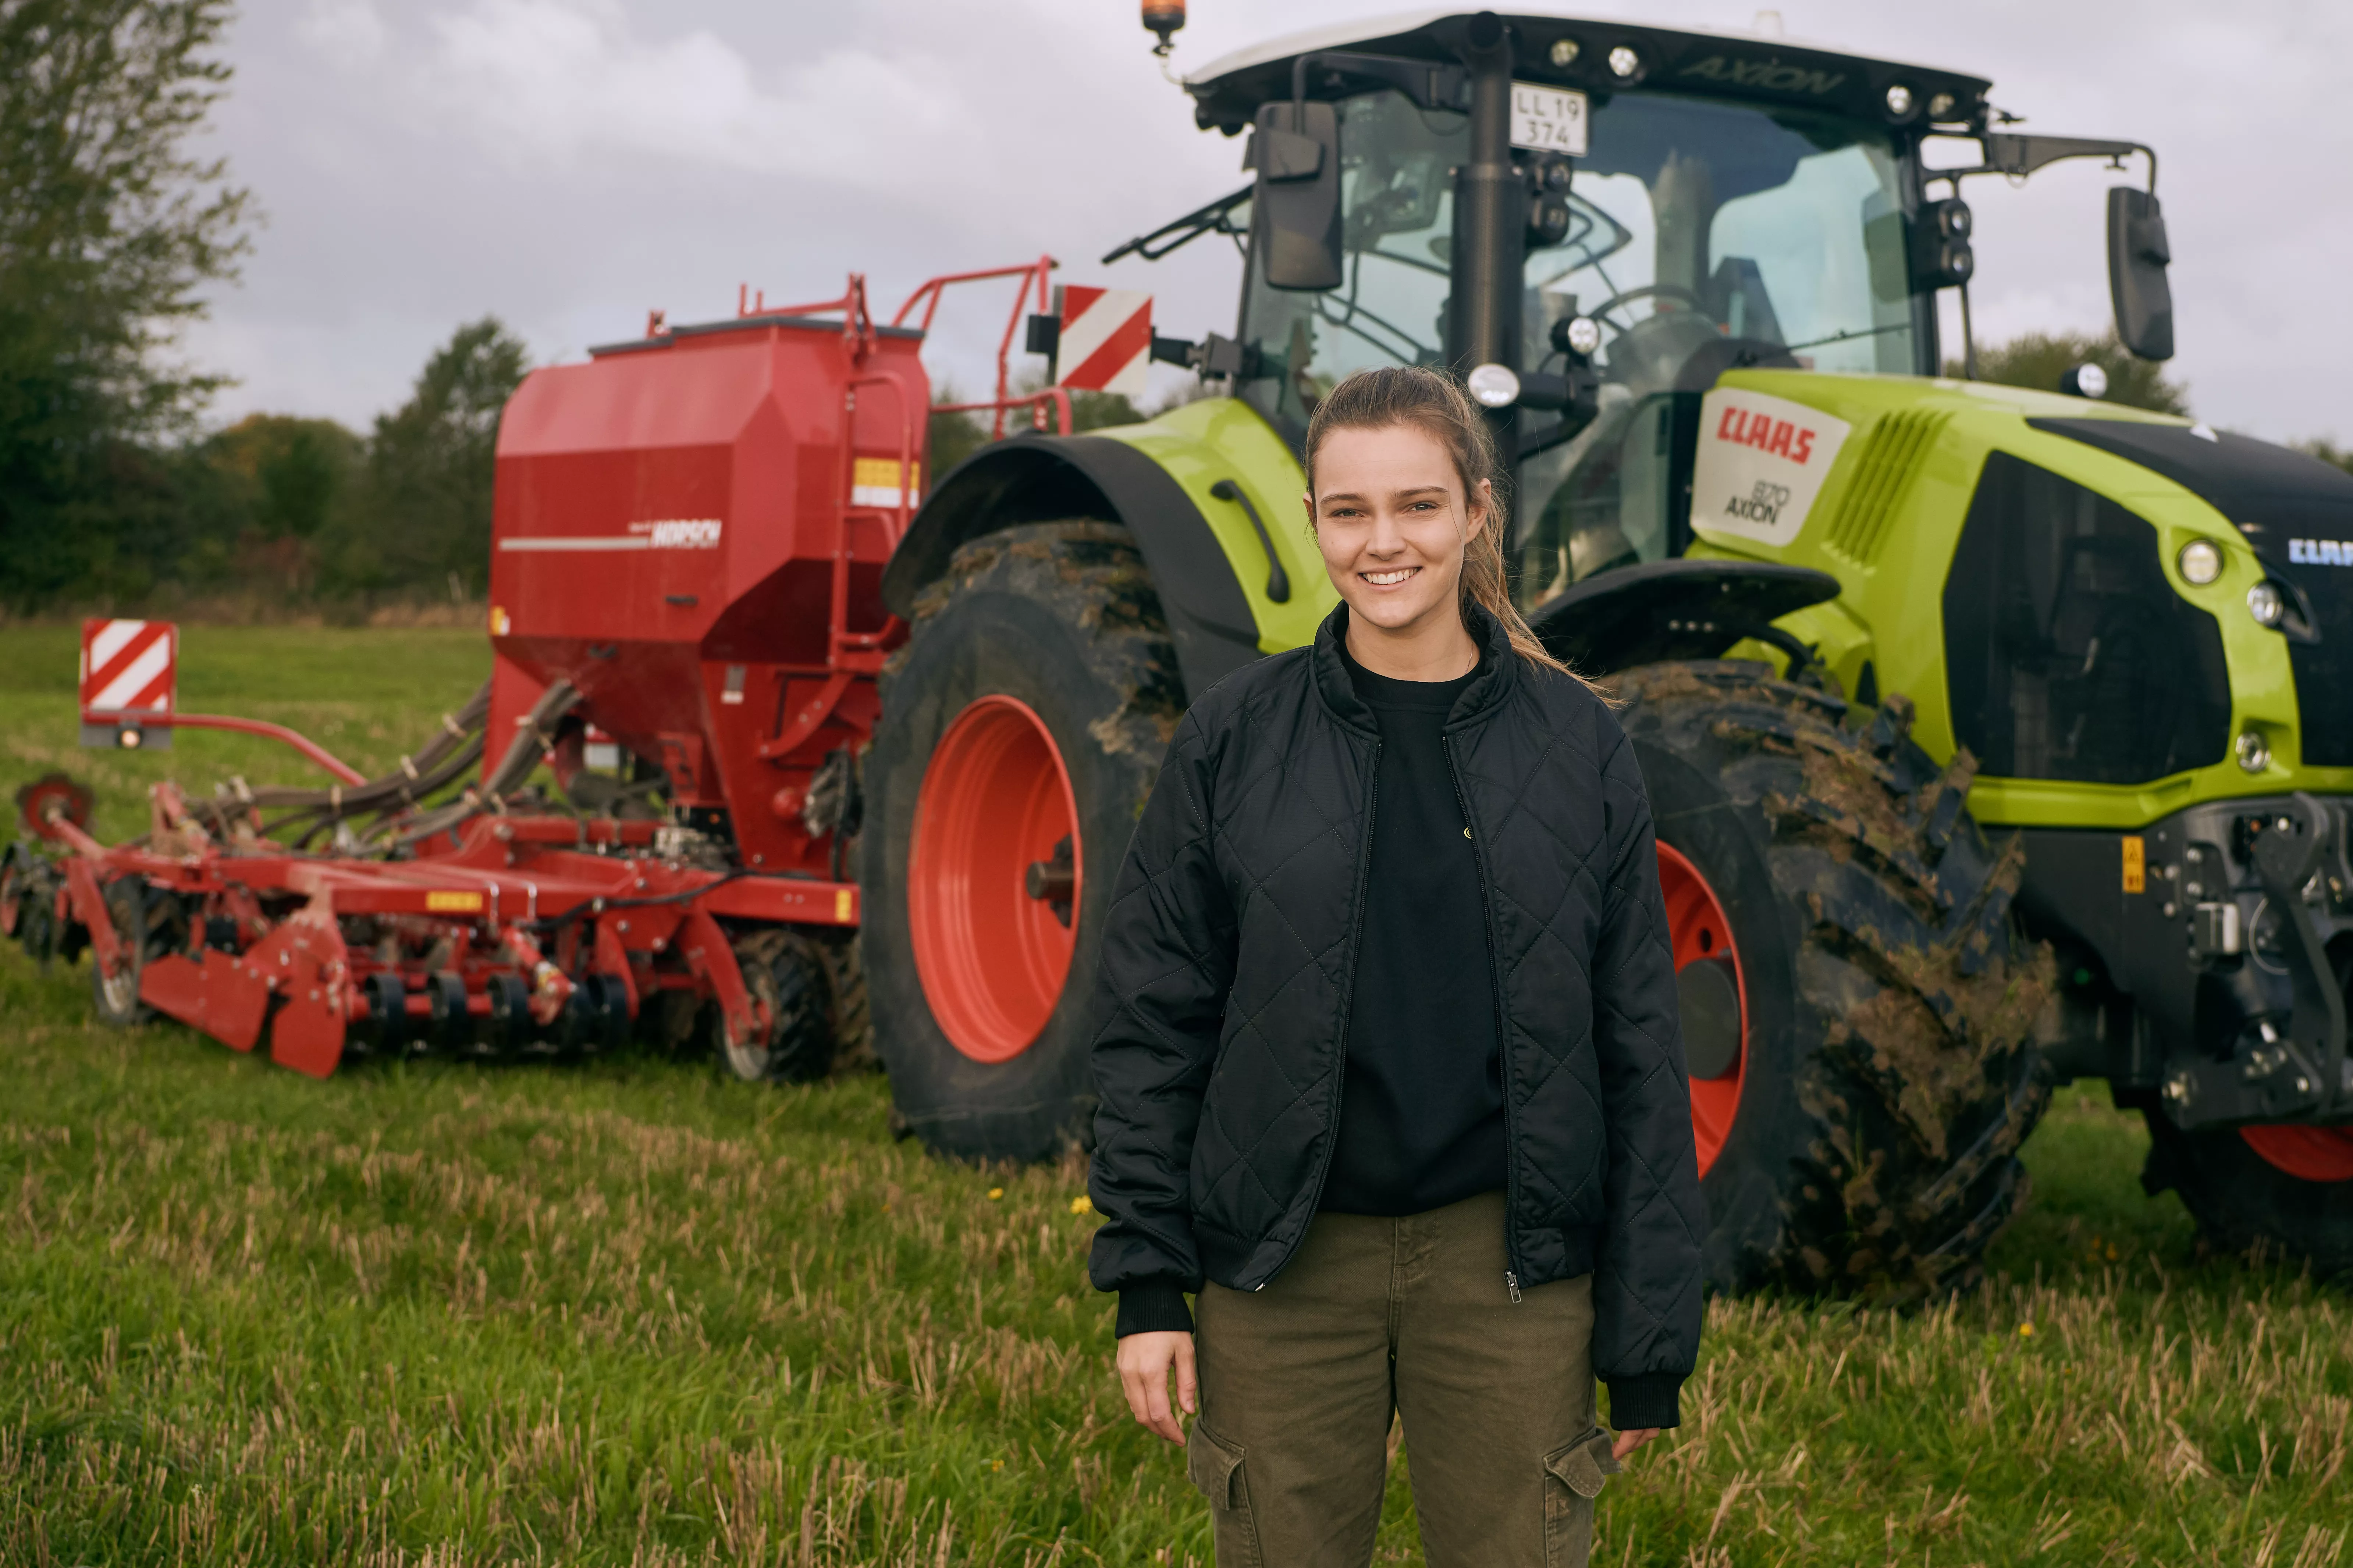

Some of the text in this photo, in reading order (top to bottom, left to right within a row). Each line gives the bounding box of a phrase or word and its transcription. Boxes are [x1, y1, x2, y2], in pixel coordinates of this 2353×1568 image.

[1517, 92, 1579, 121] LL 19
[1527, 118, 1568, 144] 374
[1716, 407, 1816, 466] CLAAS
[1724, 495, 1780, 526] AXION
